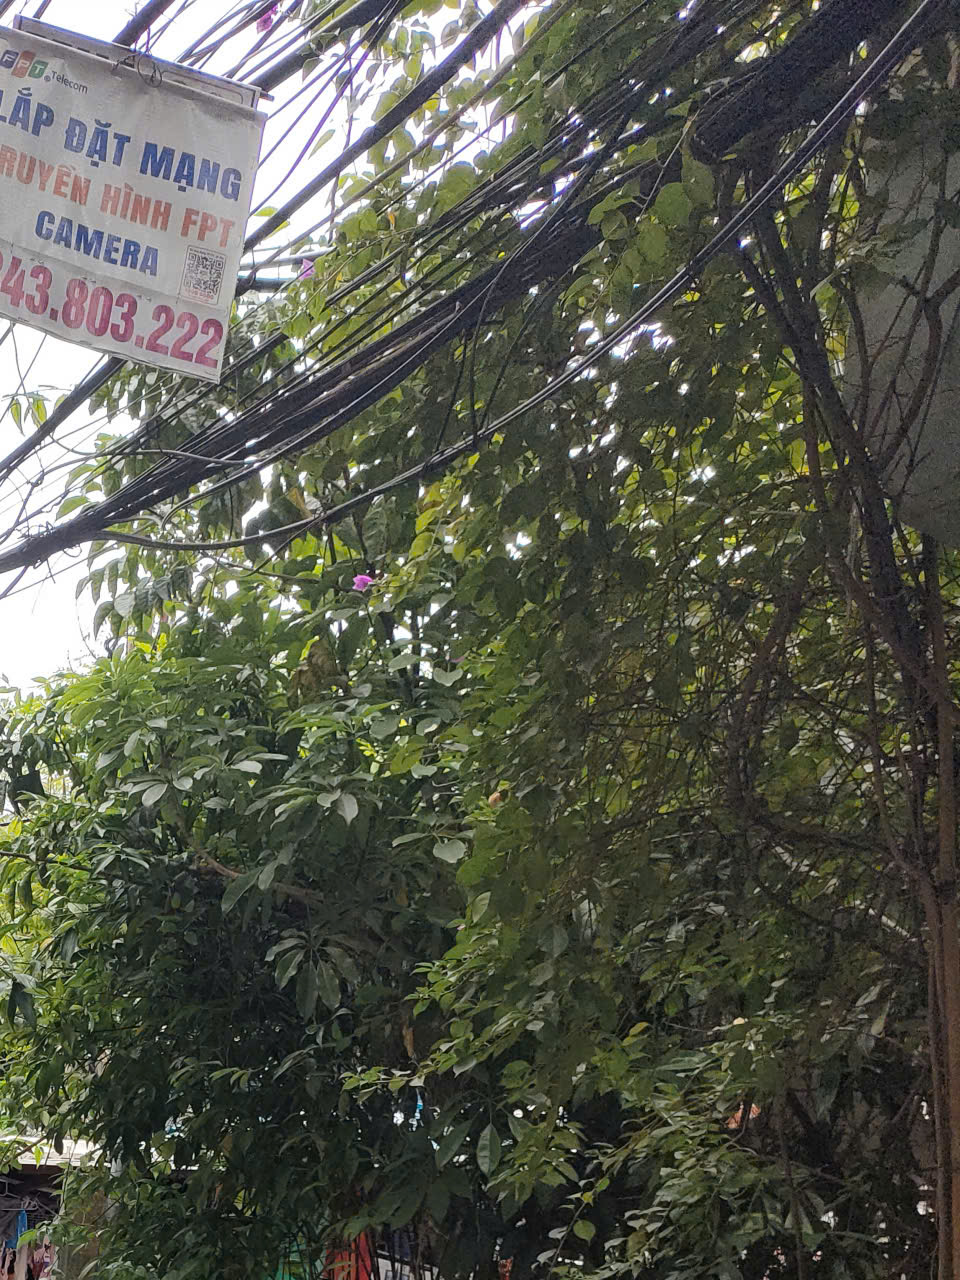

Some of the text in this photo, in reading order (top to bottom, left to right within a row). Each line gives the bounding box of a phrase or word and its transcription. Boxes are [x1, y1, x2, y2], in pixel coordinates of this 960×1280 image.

[0, 49, 88, 95] FPT Telecom
[63, 117, 131, 168] ĐẶT
[139, 141, 243, 202] MẠNG
[35, 209, 159, 277] CAMERA
[99, 182, 172, 232] HÌNH
[180, 206, 236, 248] FPT
